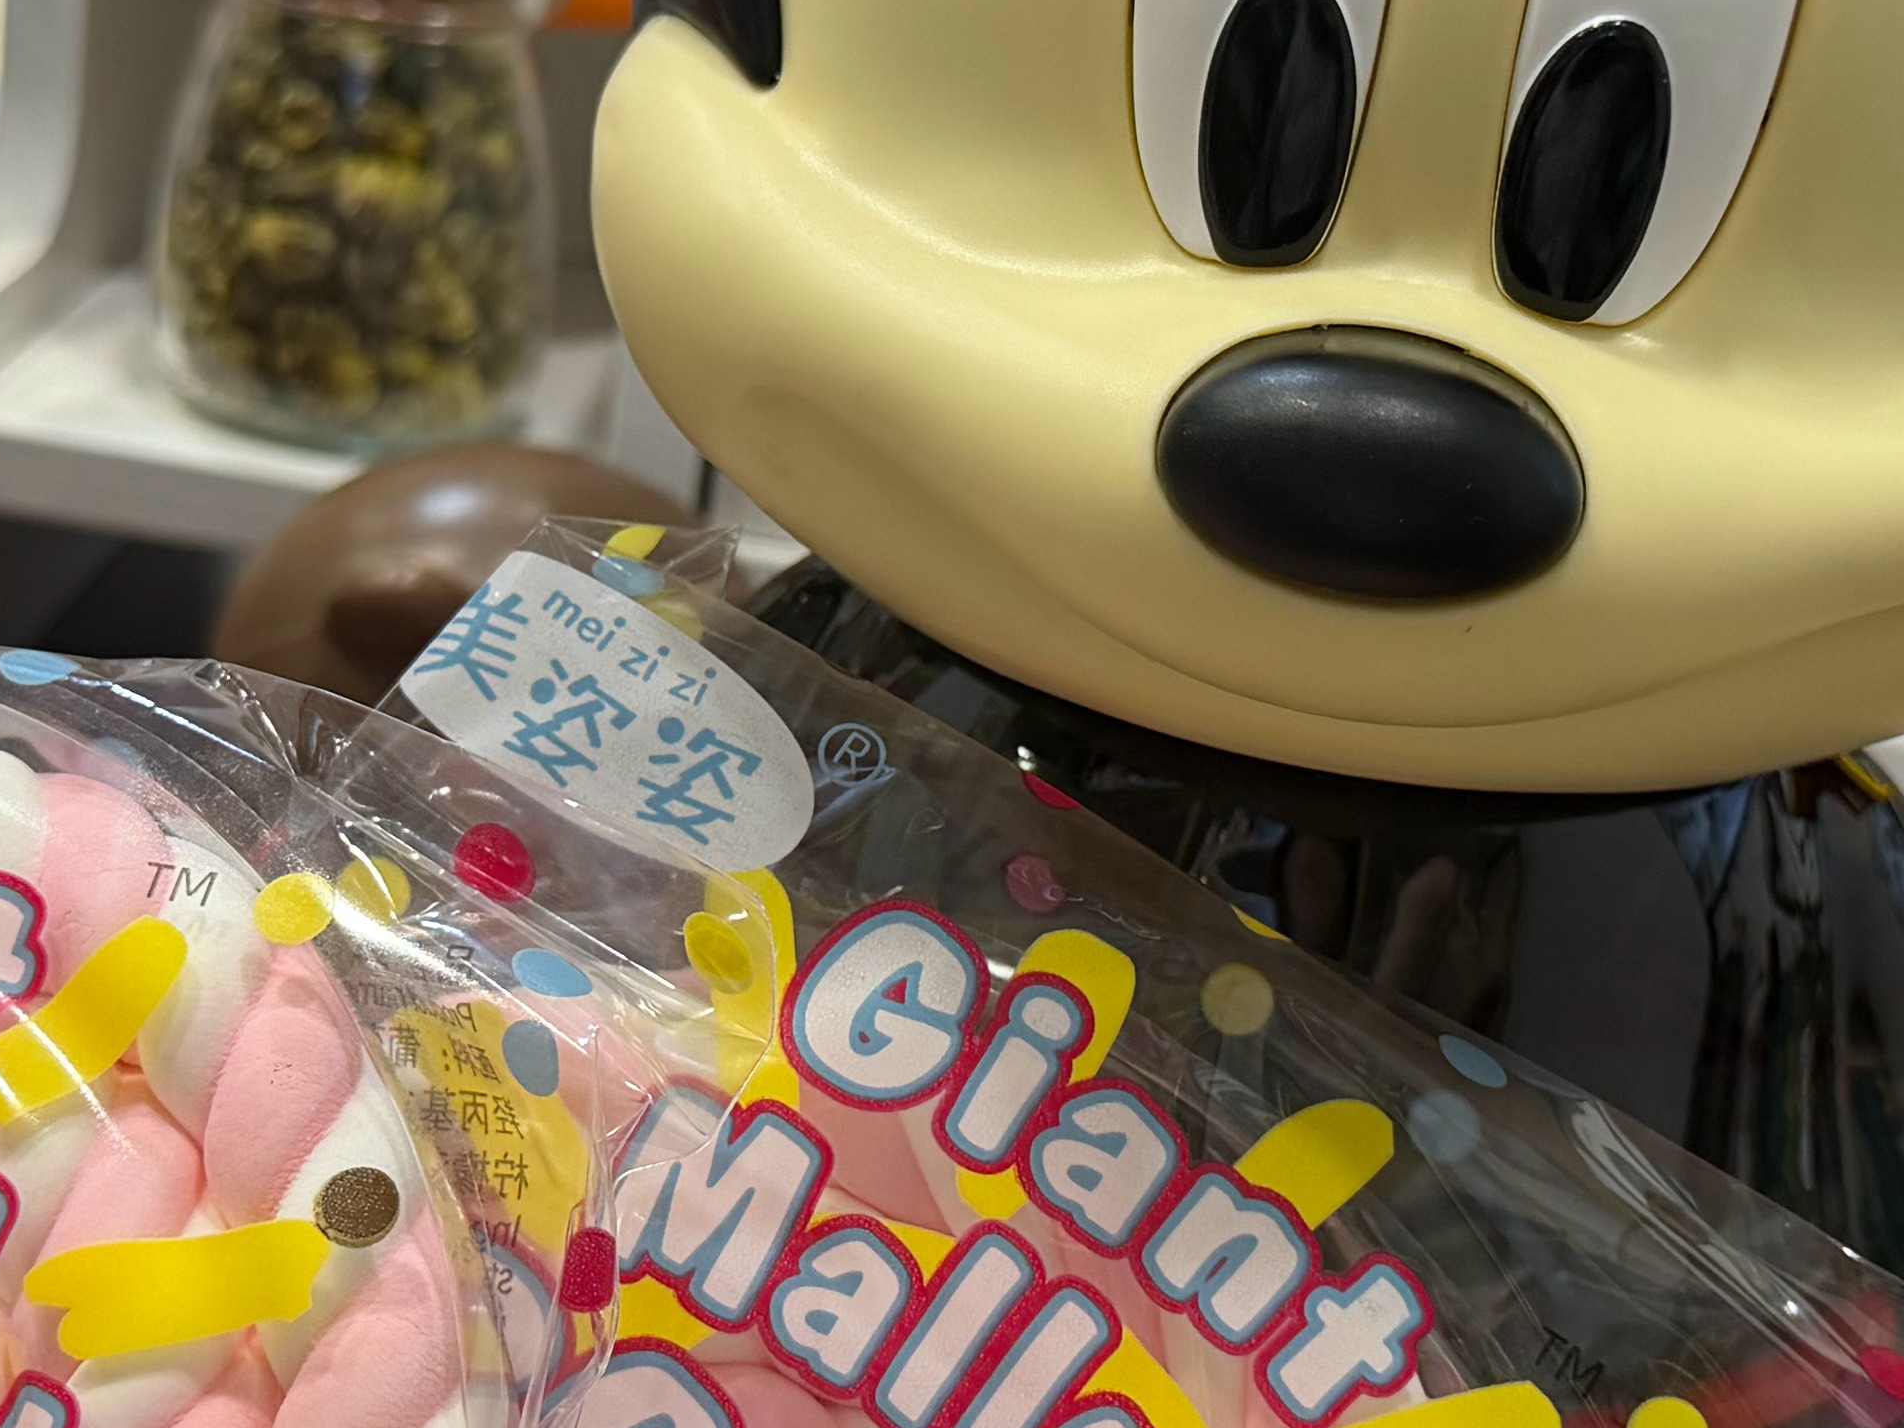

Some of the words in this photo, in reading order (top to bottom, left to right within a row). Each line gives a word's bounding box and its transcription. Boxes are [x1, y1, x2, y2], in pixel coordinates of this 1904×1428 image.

[542, 590, 627, 652] mei
[619, 645, 670, 683] zi
[667, 668, 718, 707] zi
[414, 582, 763, 846] 美姿姿
[146, 860, 219, 908] TM
